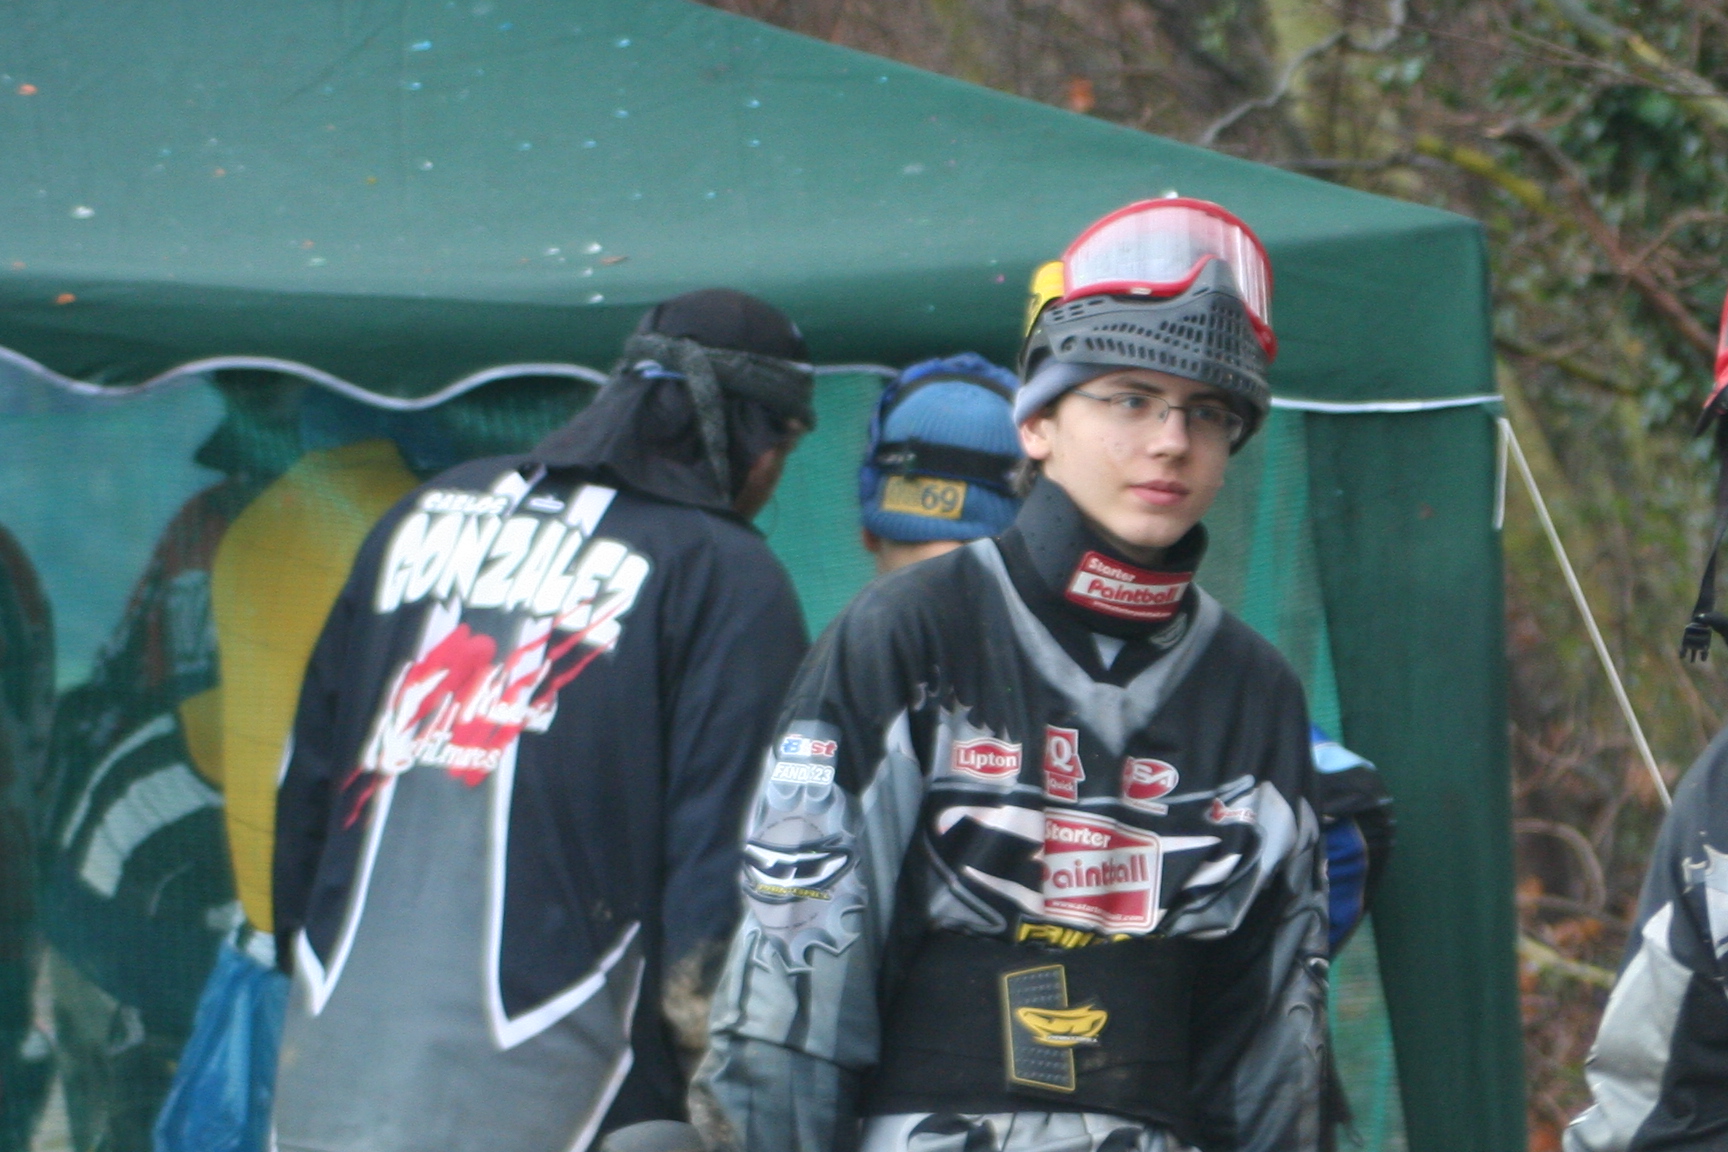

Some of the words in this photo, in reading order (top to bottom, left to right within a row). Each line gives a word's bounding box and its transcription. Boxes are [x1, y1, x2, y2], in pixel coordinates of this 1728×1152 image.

[920, 484, 960, 513] 69
[1088, 557, 1136, 583] Starter
[1087, 578, 1178, 603] Paintball
[958, 747, 1017, 769] Lipton
[1044, 820, 1112, 849] Starter
